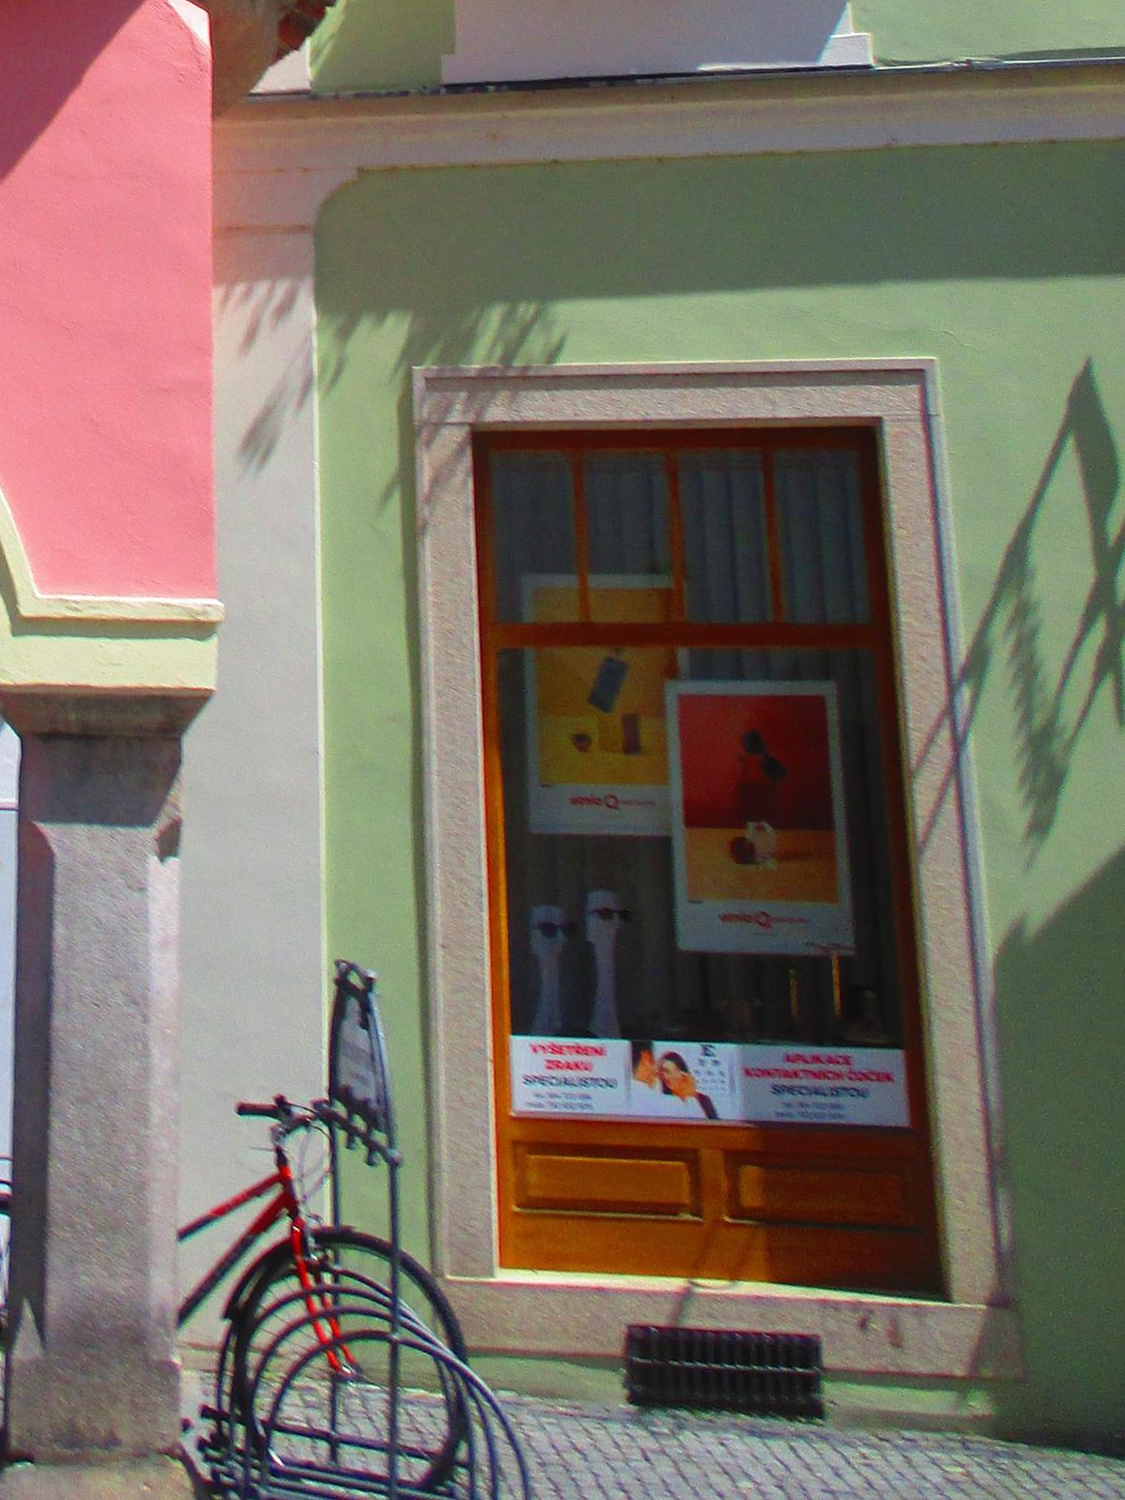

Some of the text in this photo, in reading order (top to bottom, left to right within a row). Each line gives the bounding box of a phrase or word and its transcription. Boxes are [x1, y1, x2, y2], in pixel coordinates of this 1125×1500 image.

[544, 1059, 593, 1072] ZRAKU
[784, 1053, 853, 1066] APLIKACE
[743, 1066, 844, 1080] KONTAKTNÍCH
[522, 1074, 618, 1089] SPECIALISTOU
[771, 1084, 871, 1098] SPECIALISTOU
